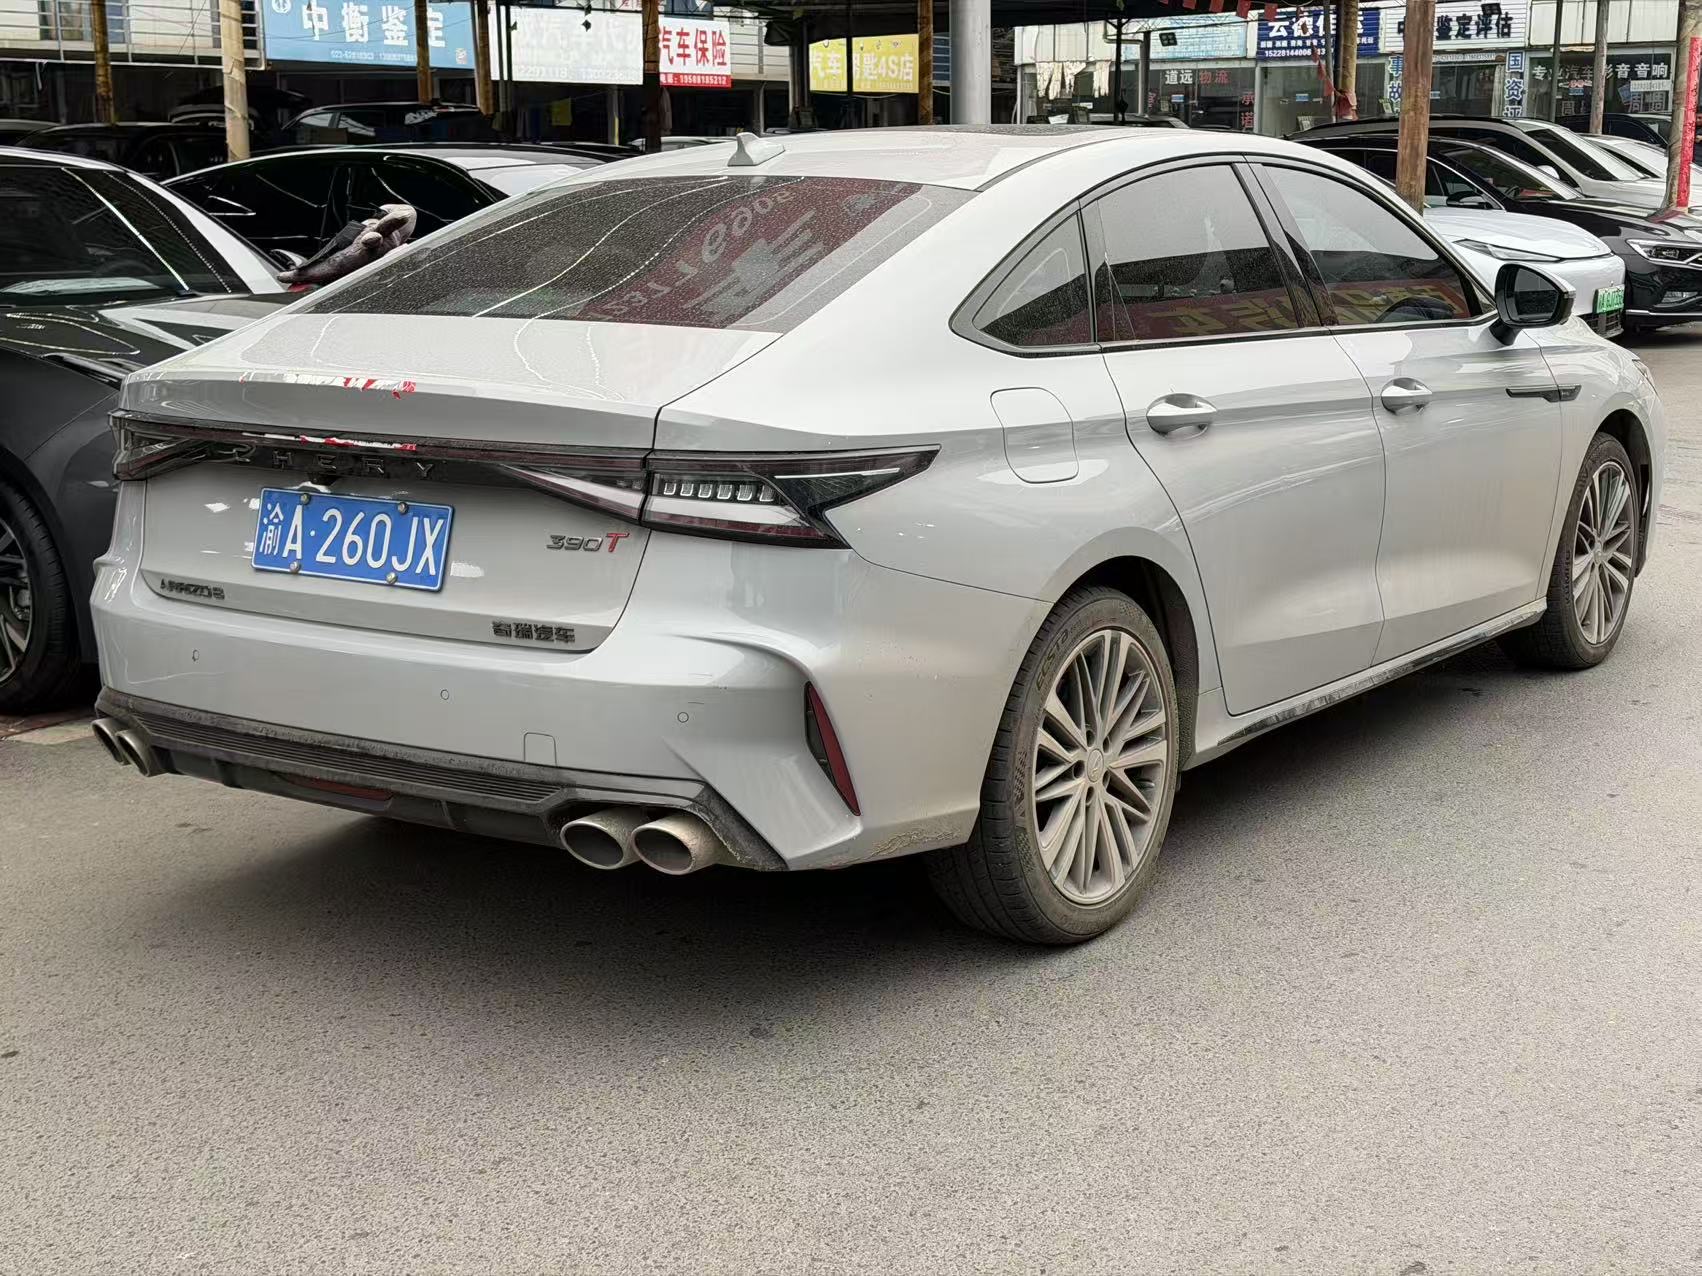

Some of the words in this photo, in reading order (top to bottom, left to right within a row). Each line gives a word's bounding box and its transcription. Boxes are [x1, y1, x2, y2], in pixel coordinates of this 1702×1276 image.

[302, 2, 446, 48] 中衡鉴定
[1268, 11, 1364, 38] 云德信
[1398, 11, 1513, 41] 中鉴定评估
[660, 26, 727, 66] 汽车保险
[1164, 69, 1231, 86] 道远物流
[259, 502, 445, 576] 渝A·260JX
[546, 532, 630, 553] 390T
[492, 620, 576, 643] 奇瑞汽车
